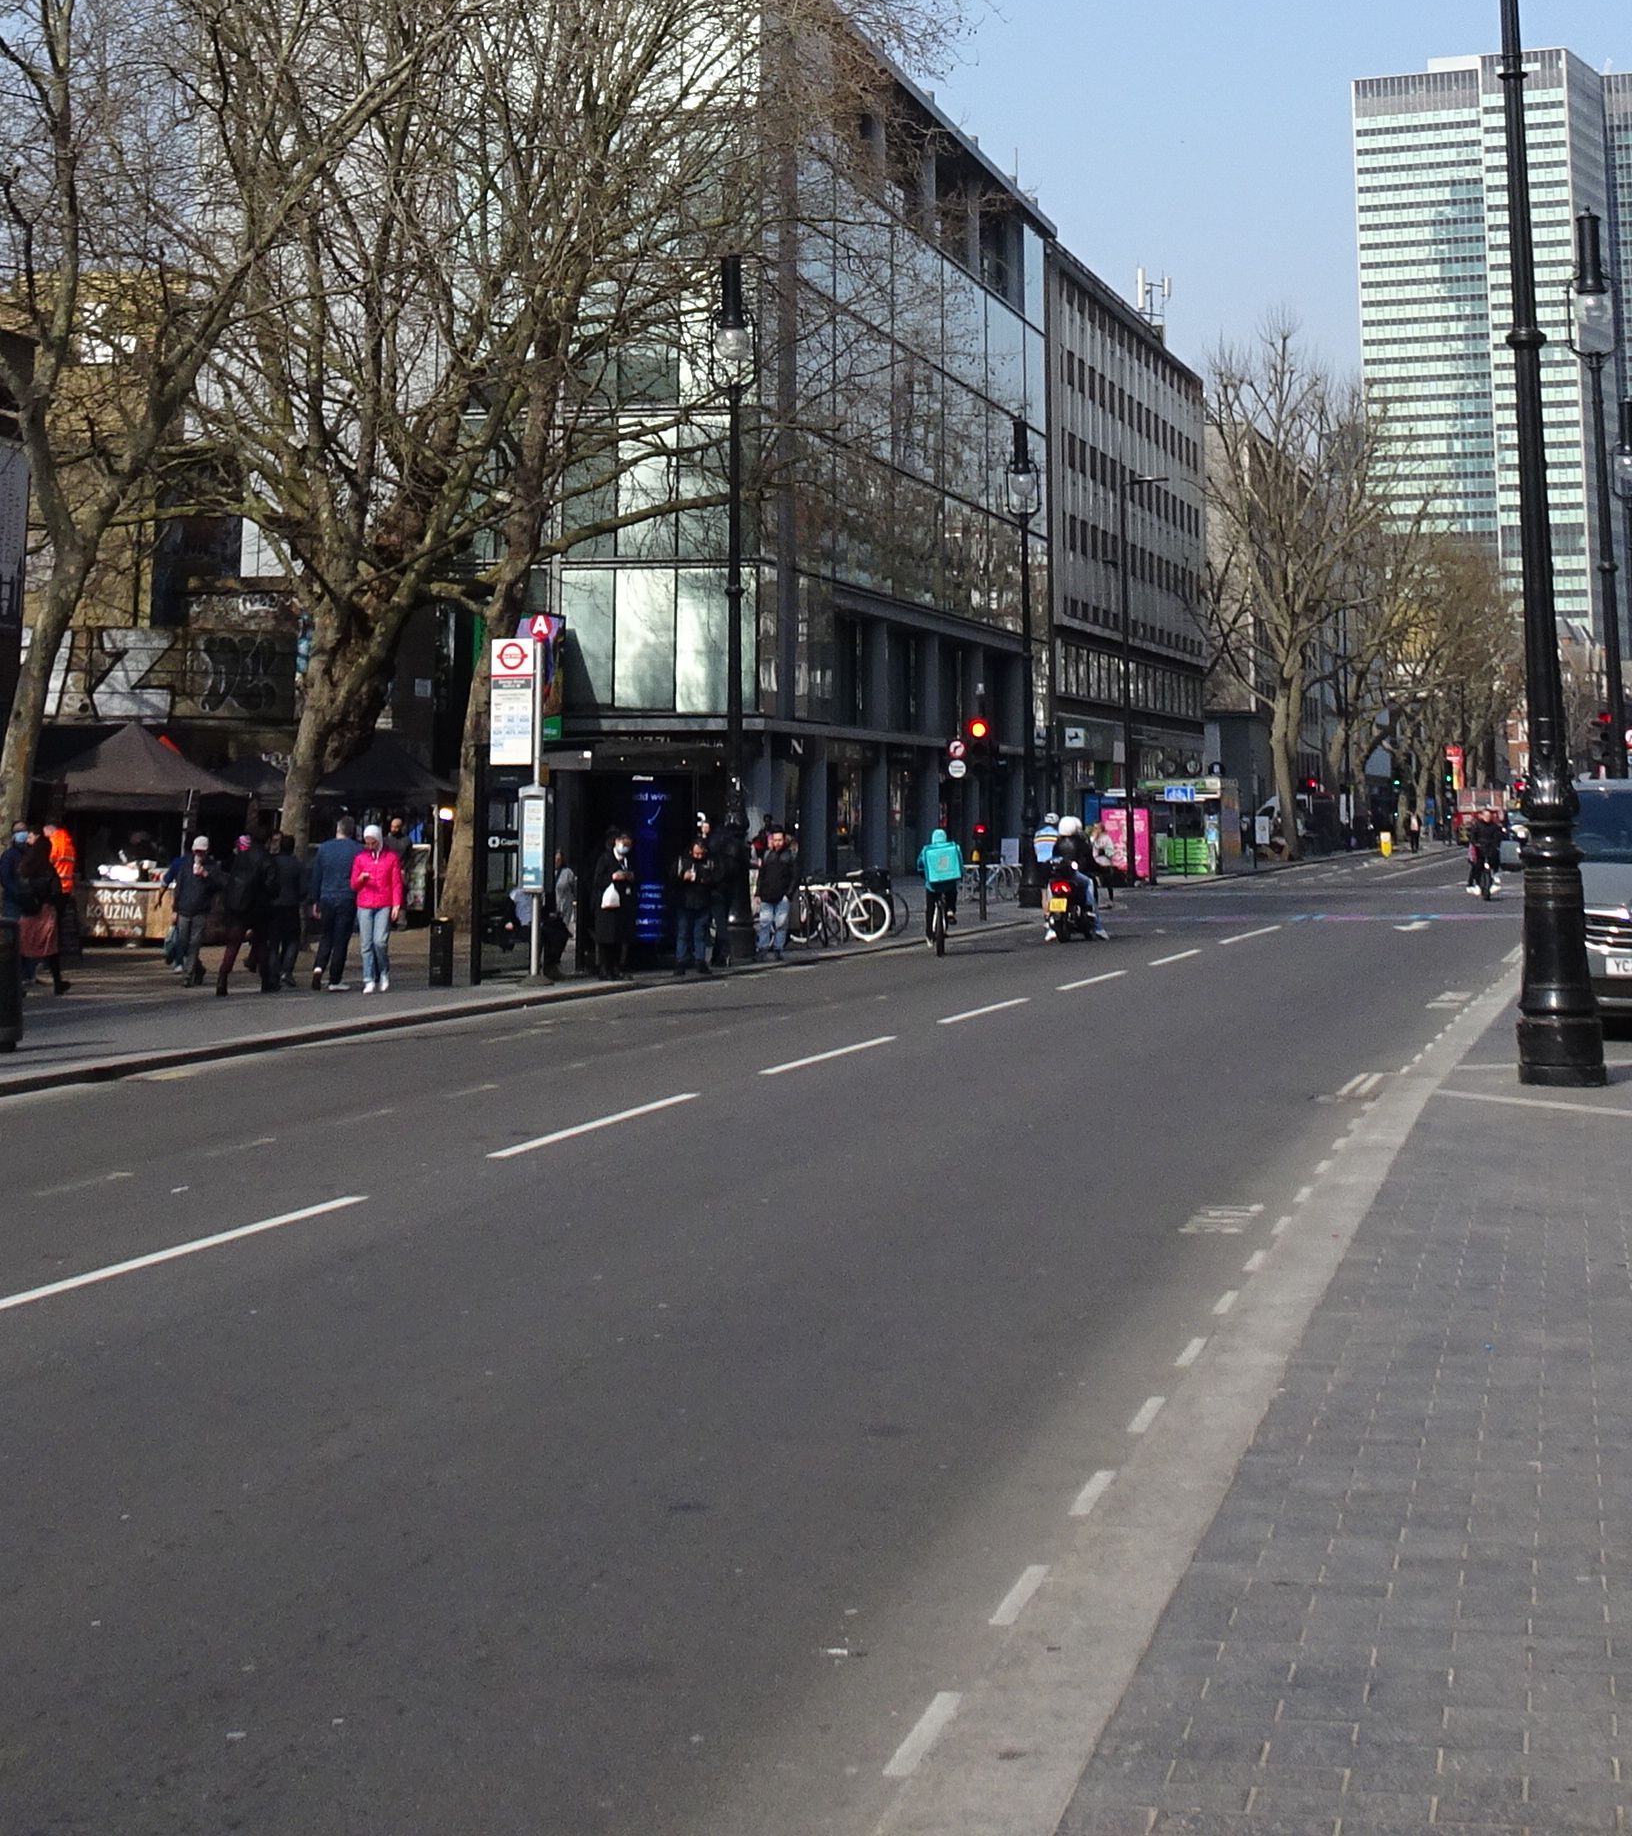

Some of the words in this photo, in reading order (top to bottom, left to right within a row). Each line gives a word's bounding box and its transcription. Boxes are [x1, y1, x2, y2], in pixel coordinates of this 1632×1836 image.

[532, 615, 549, 635] A
[95, 889, 138, 904] GREEK
[86, 904, 144, 920] KOUZINA
